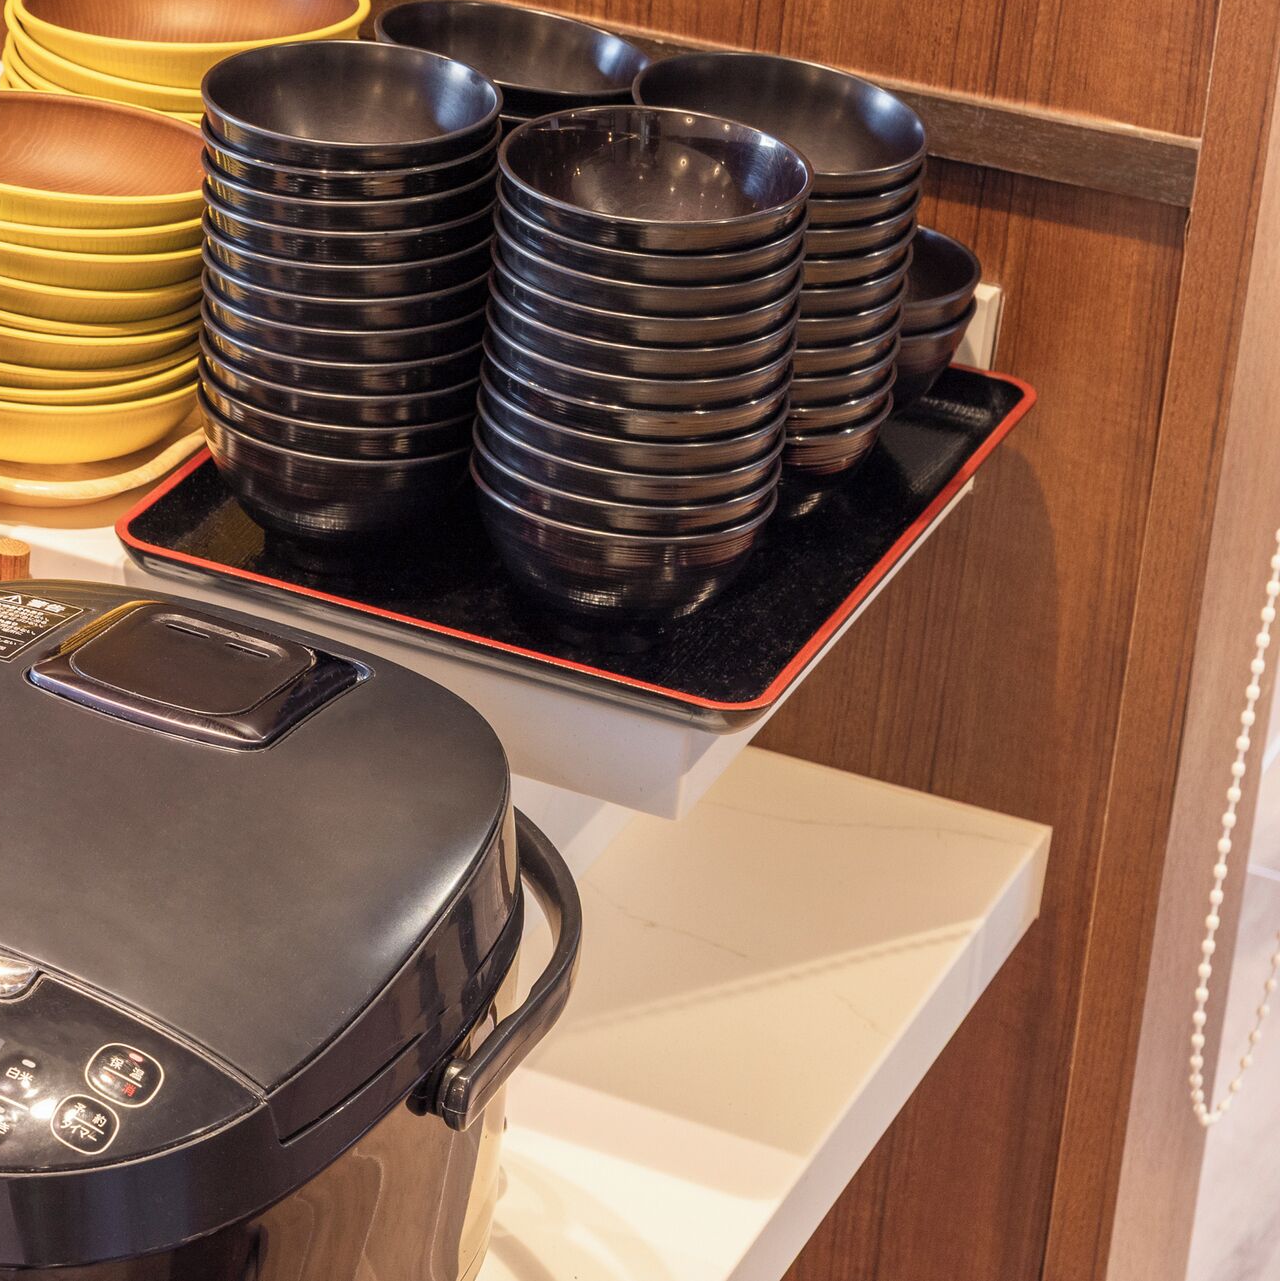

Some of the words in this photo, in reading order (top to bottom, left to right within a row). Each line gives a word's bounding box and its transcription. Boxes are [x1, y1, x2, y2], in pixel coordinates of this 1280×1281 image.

[5, 1066, 35, 1084] 白米
[108, 1056, 145, 1081] 保温
[73, 1101, 108, 1128] 予約
[59, 1119, 99, 1142] タイマー
